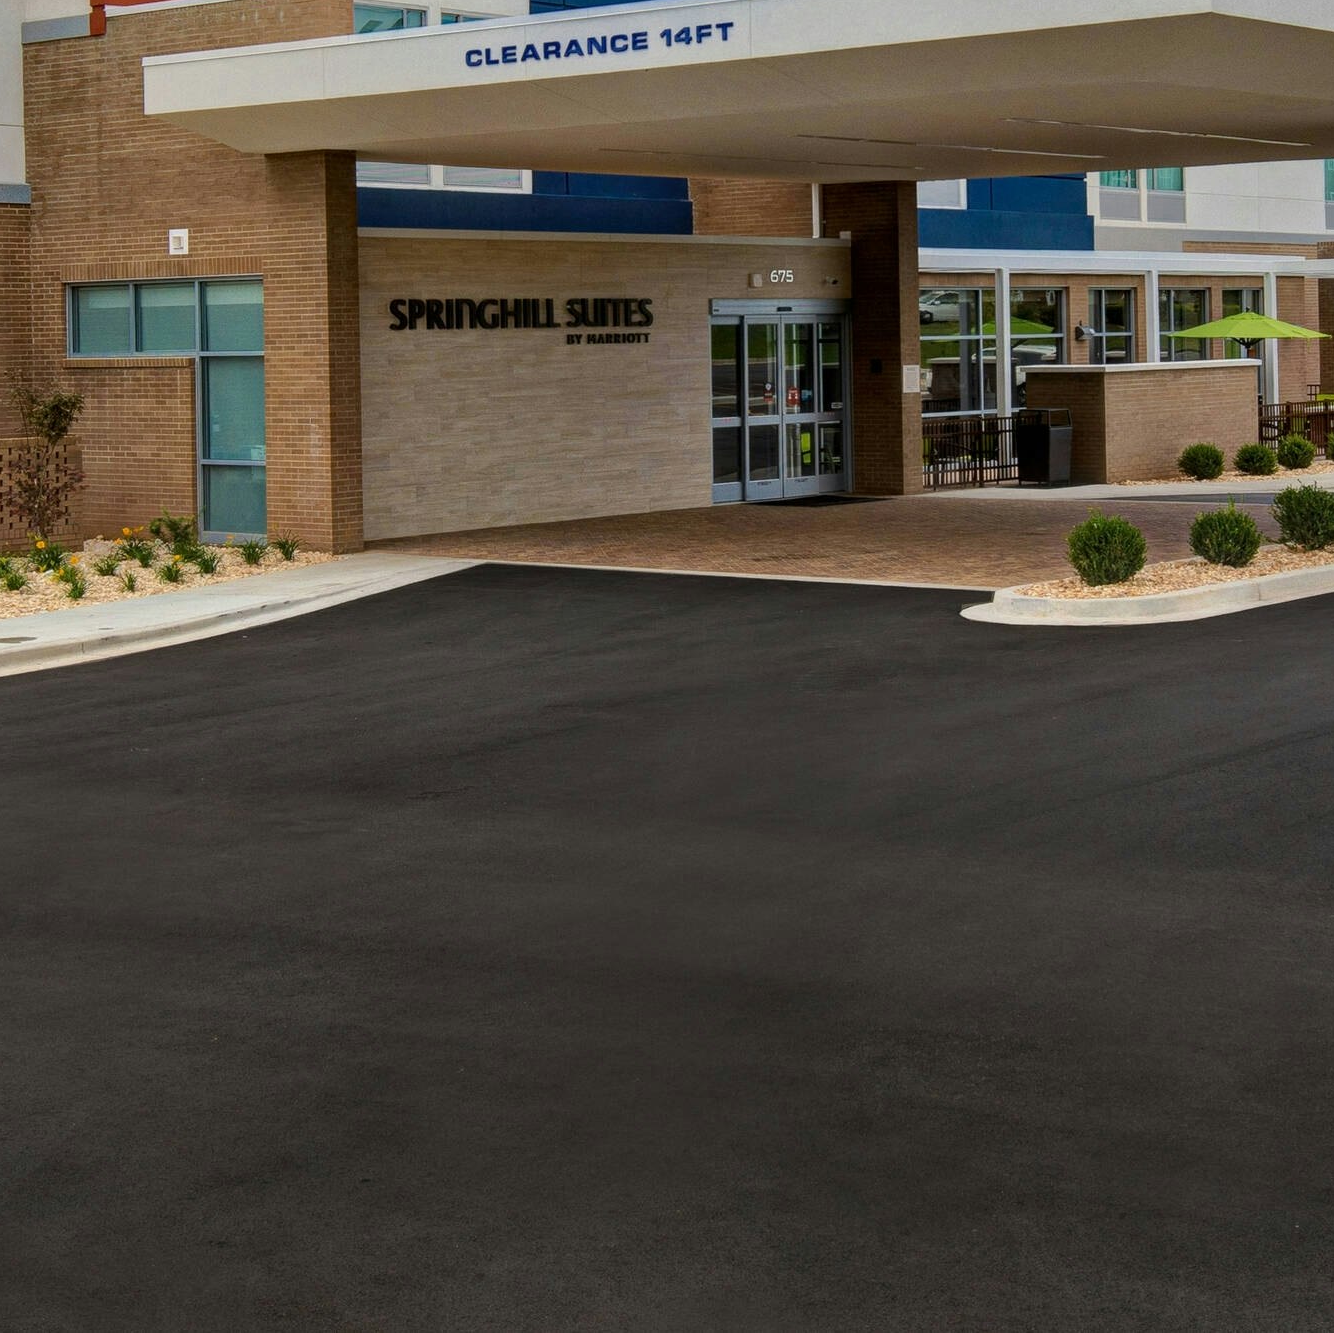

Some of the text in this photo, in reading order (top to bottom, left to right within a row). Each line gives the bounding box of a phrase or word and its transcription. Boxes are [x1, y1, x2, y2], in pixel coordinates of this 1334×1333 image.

[465, 21, 735, 68] CLEARANCE 14FT
[770, 269, 794, 283] 675
[388, 297, 654, 331] SPRINGHILL SUITES
[567, 332, 651, 345] BY MARRIOTT
